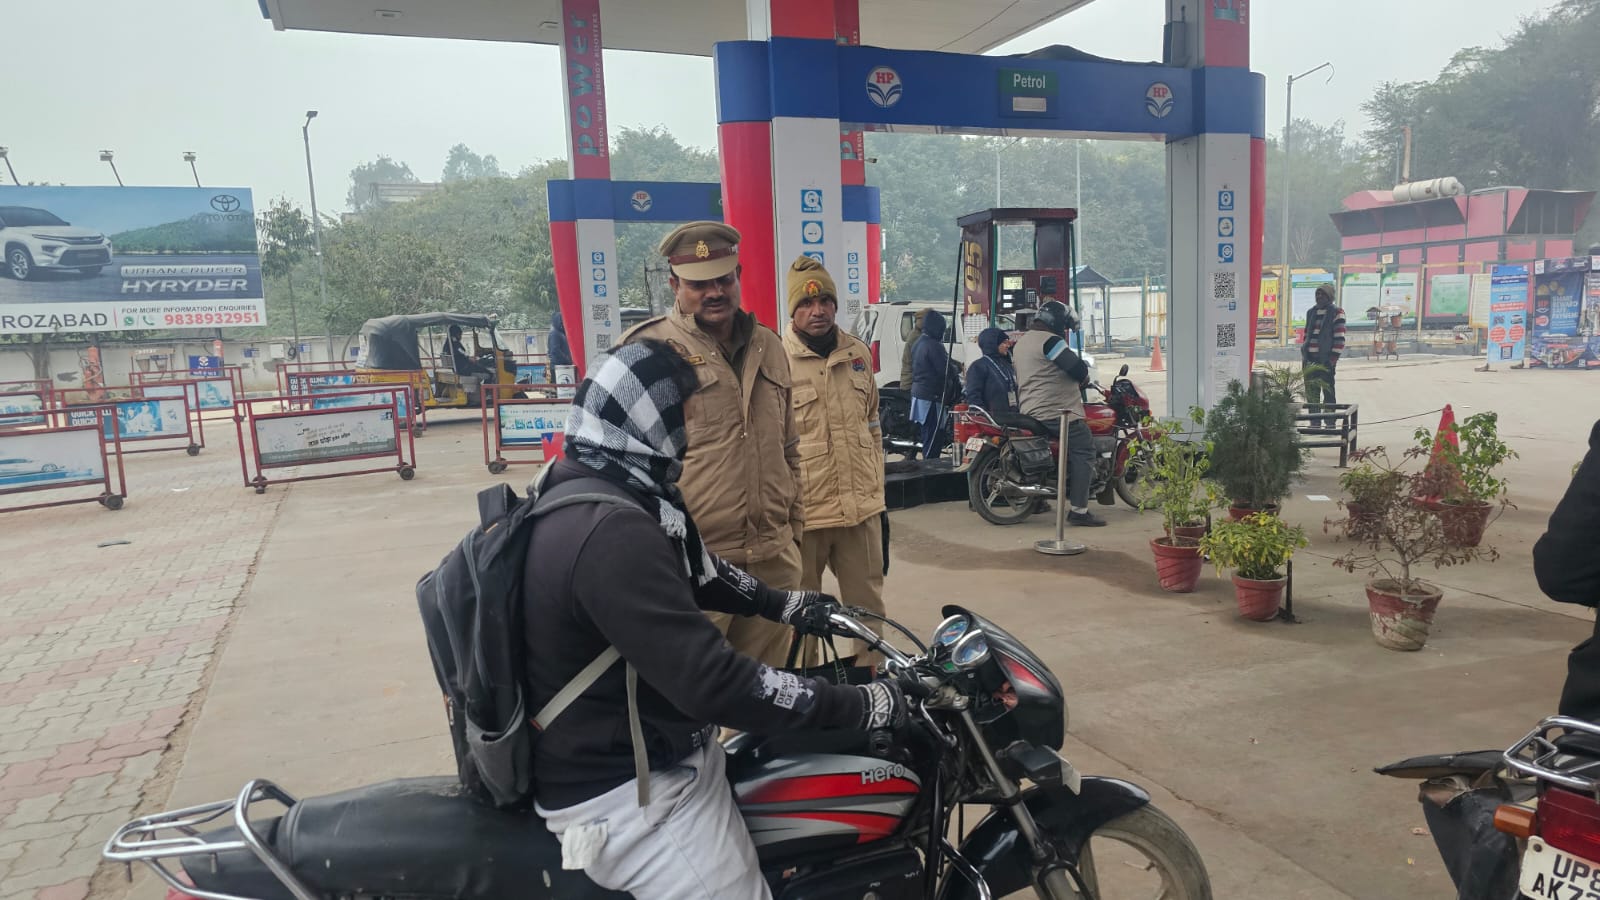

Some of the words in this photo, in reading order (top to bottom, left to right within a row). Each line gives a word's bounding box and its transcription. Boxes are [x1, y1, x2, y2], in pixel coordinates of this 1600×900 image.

[875, 71, 894, 84] HP
[1013, 73, 1046, 89] Petrol
[1152, 86, 1169, 98] HP
[124, 267, 177, 275] URBAN
[181, 266, 246, 275] CRUISER
[121, 278, 249, 294] HYRYDER
[218, 304, 257, 312] ENQUIRIES
[164, 312, 260, 325] 9838932951
[861, 763, 905, 785] Hero
